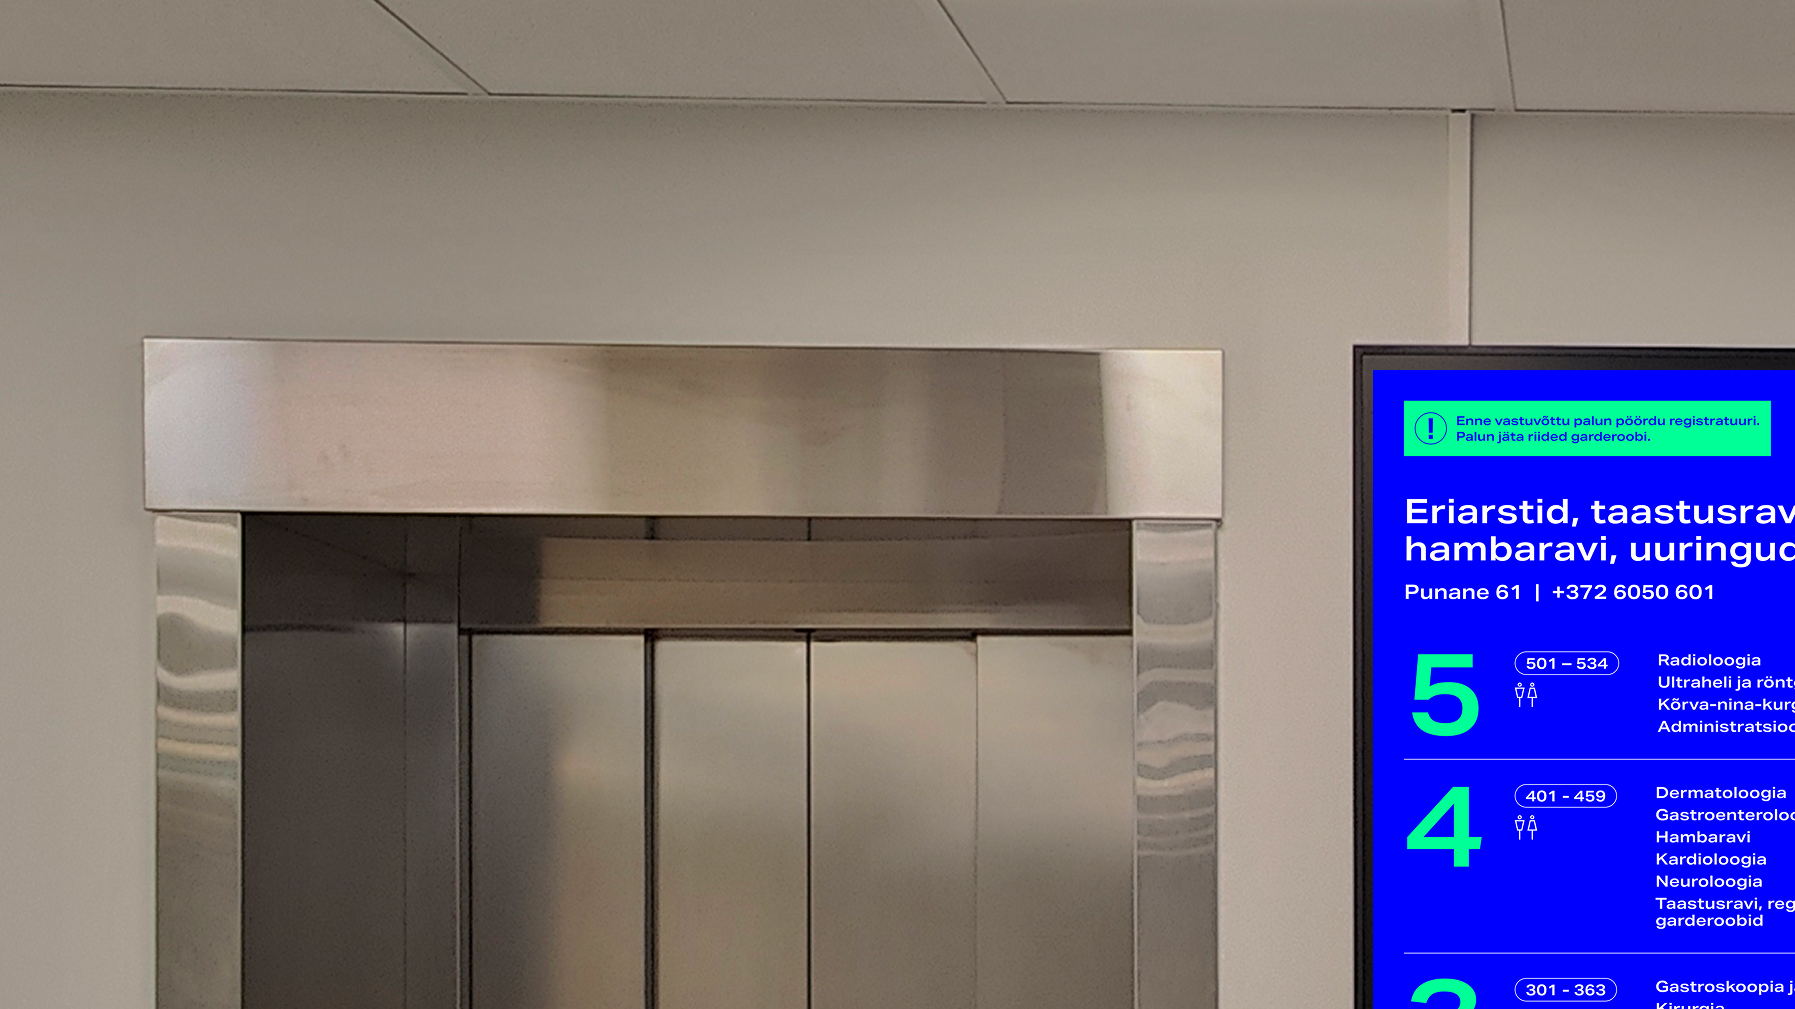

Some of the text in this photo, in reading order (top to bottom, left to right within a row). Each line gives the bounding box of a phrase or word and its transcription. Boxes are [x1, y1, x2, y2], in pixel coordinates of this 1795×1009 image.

[1457, 416, 1759, 428] Enne vastuvõttu palun pöördu registratuuri.
[1457, 432, 1650, 443] Palun jäta riided garderoobi.
[1407, 499, 1578, 527] Eriarstid,
[1406, 536, 1616, 564] hambaravi,
[1406, 584, 1489, 599] Punane
[1496, 585, 1519, 599] 61
[1553, 585, 1606, 599] +372
[1614, 585, 1668, 599] 6050
[1676, 585, 1712, 599] 601
[1527, 658, 1555, 669] 501
[1577, 658, 1608, 669] 534
[1659, 654, 1760, 669] Radioloogia
[1659, 676, 1731, 688] Ultraheli
[1735, 676, 1751, 691] ja
[1412, 654, 1479, 736] 5
[1526, 790, 1555, 802] 401
[1574, 790, 1605, 802] 459
[1657, 787, 1786, 801] Dermatoloogia
[1407, 787, 1482, 867] 4
[1657, 831, 1750, 843] Hambaravi
[1657, 853, 1766, 868] Kardioloogia
[1657, 875, 1762, 890] Neuroloogia
[1655, 898, 1762, 910] Taastusravi,
[1656, 914, 1763, 929] garderoobid
[1526, 984, 1555, 996] 301
[1574, 984, 1605, 996] 363
[1656, 980, 1784, 995] Gastroskoopia
